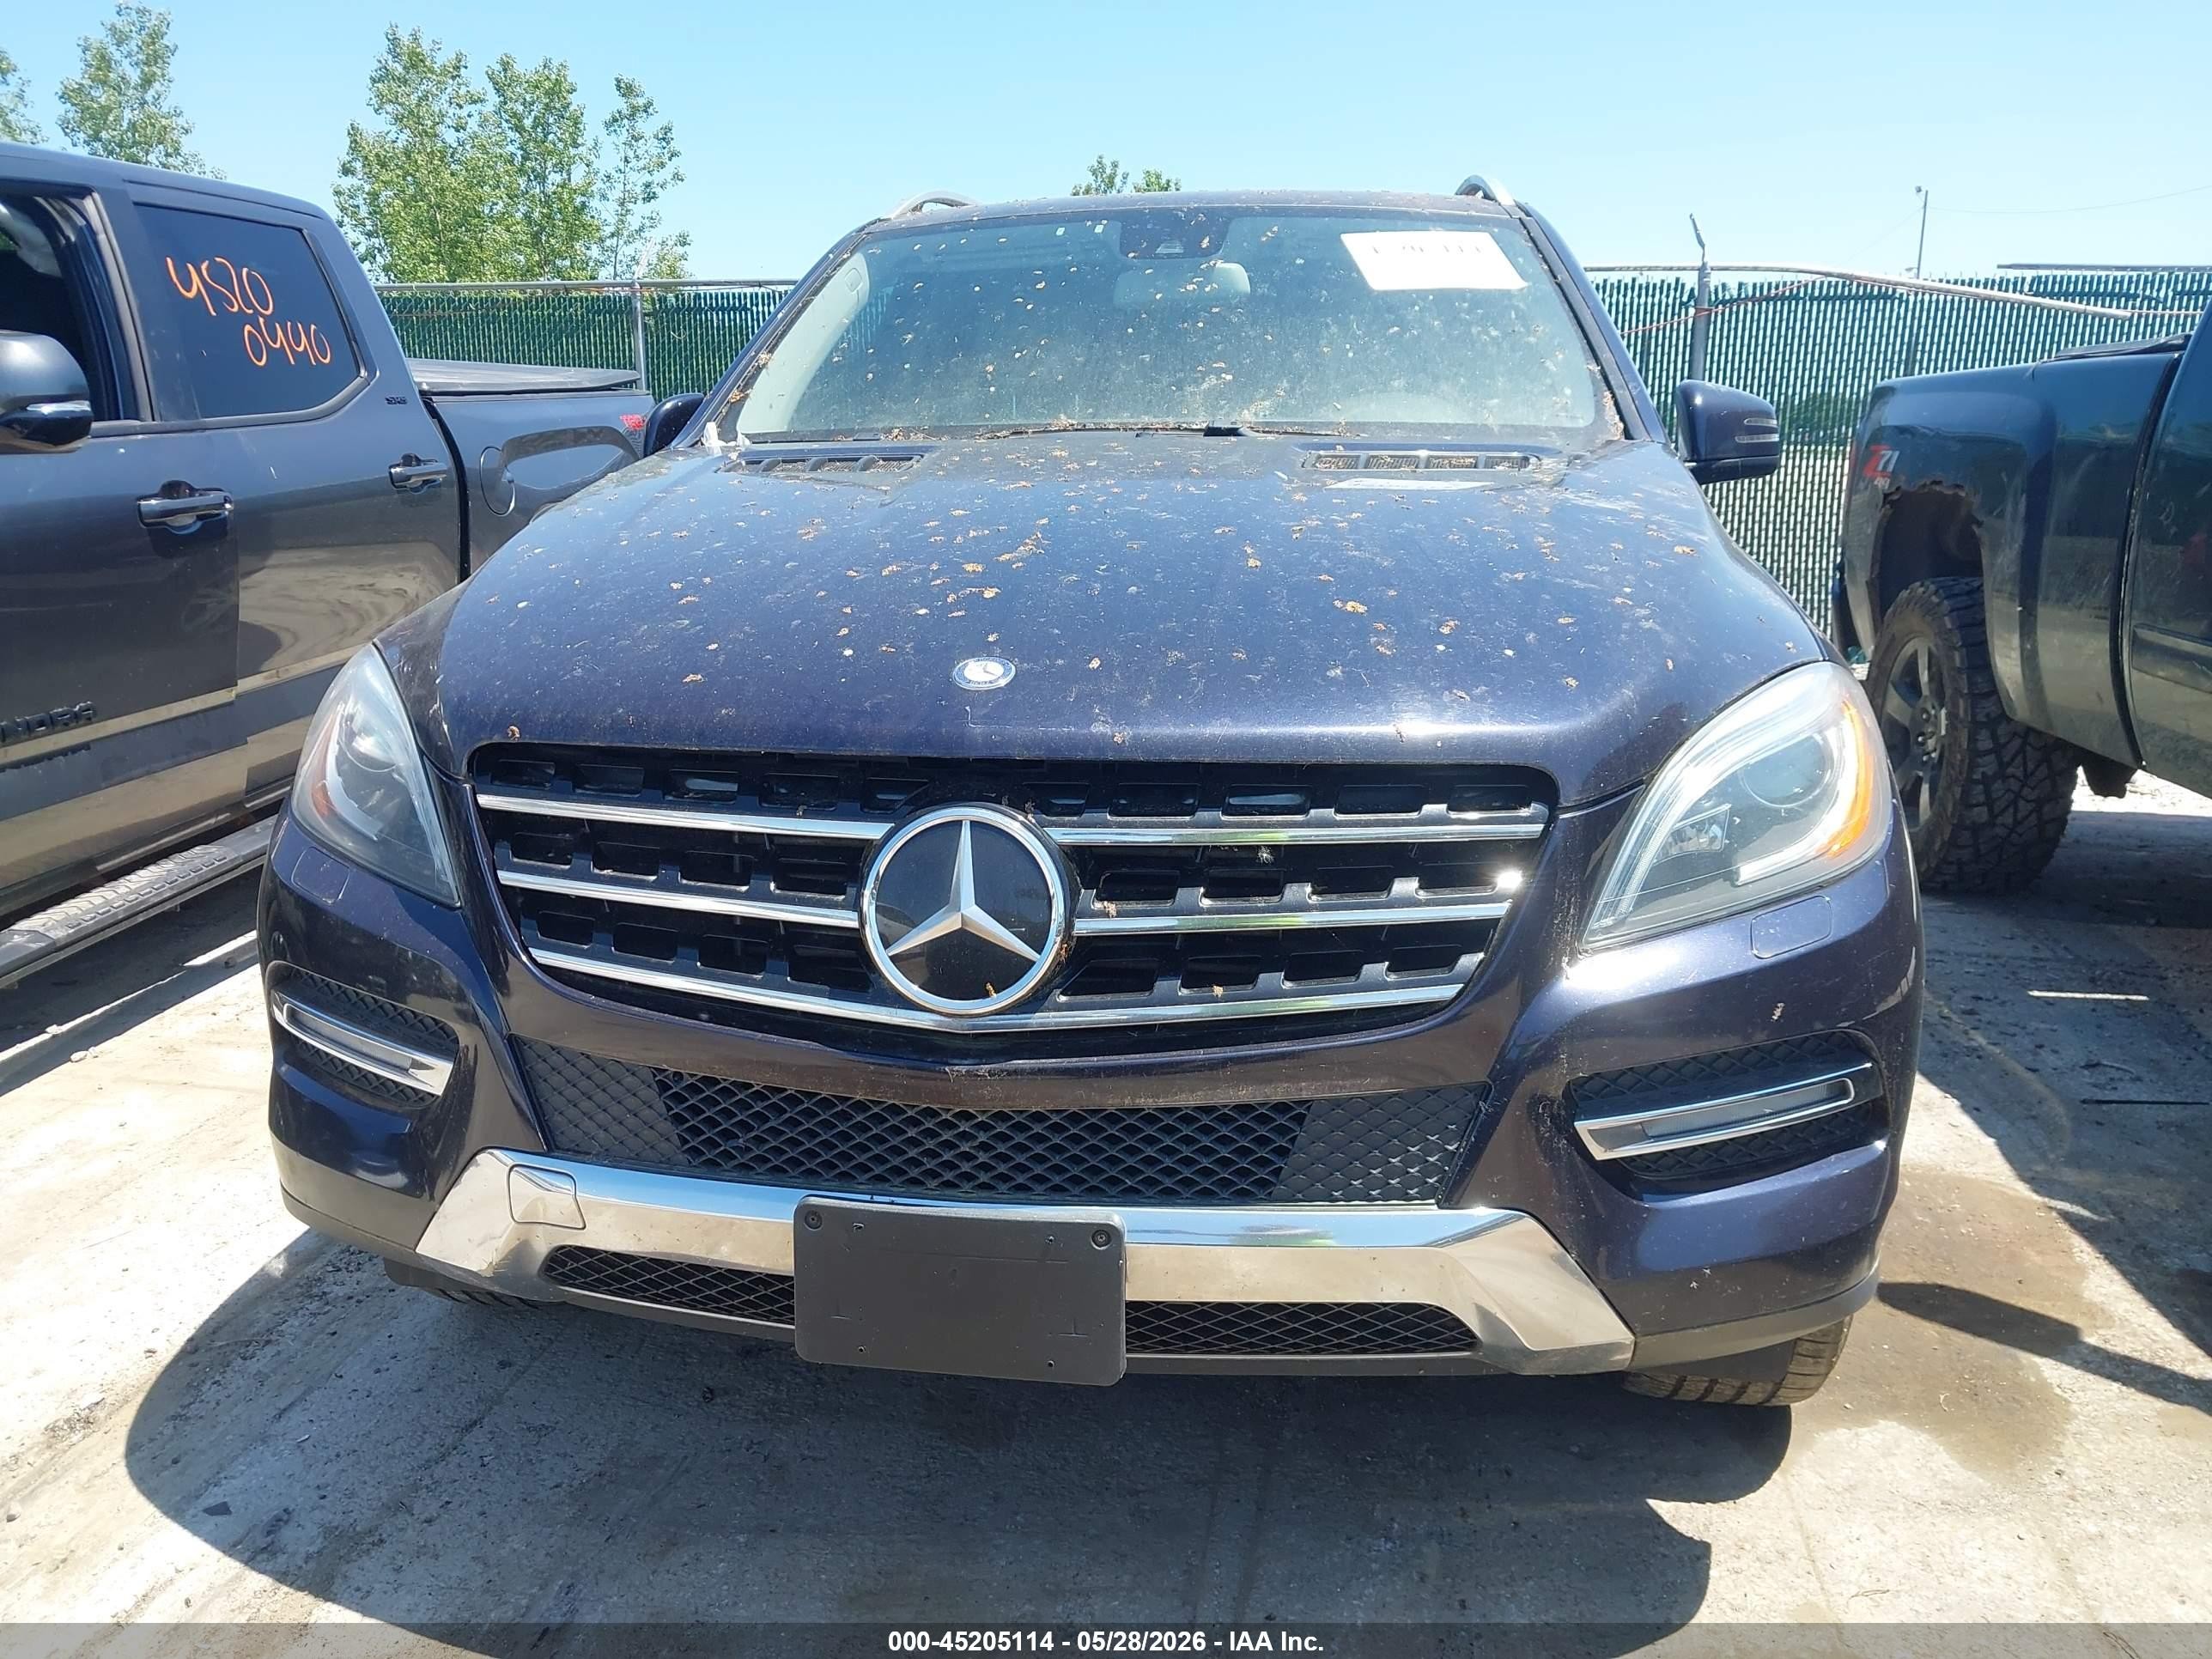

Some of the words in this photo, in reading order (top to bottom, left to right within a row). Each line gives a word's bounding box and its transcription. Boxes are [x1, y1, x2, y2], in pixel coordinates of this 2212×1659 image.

[165, 256, 275, 317] 4520
[243, 314, 331, 367] 0440
[1863, 443, 1900, 478] Z71
[0, 701, 96, 742] NDRA
